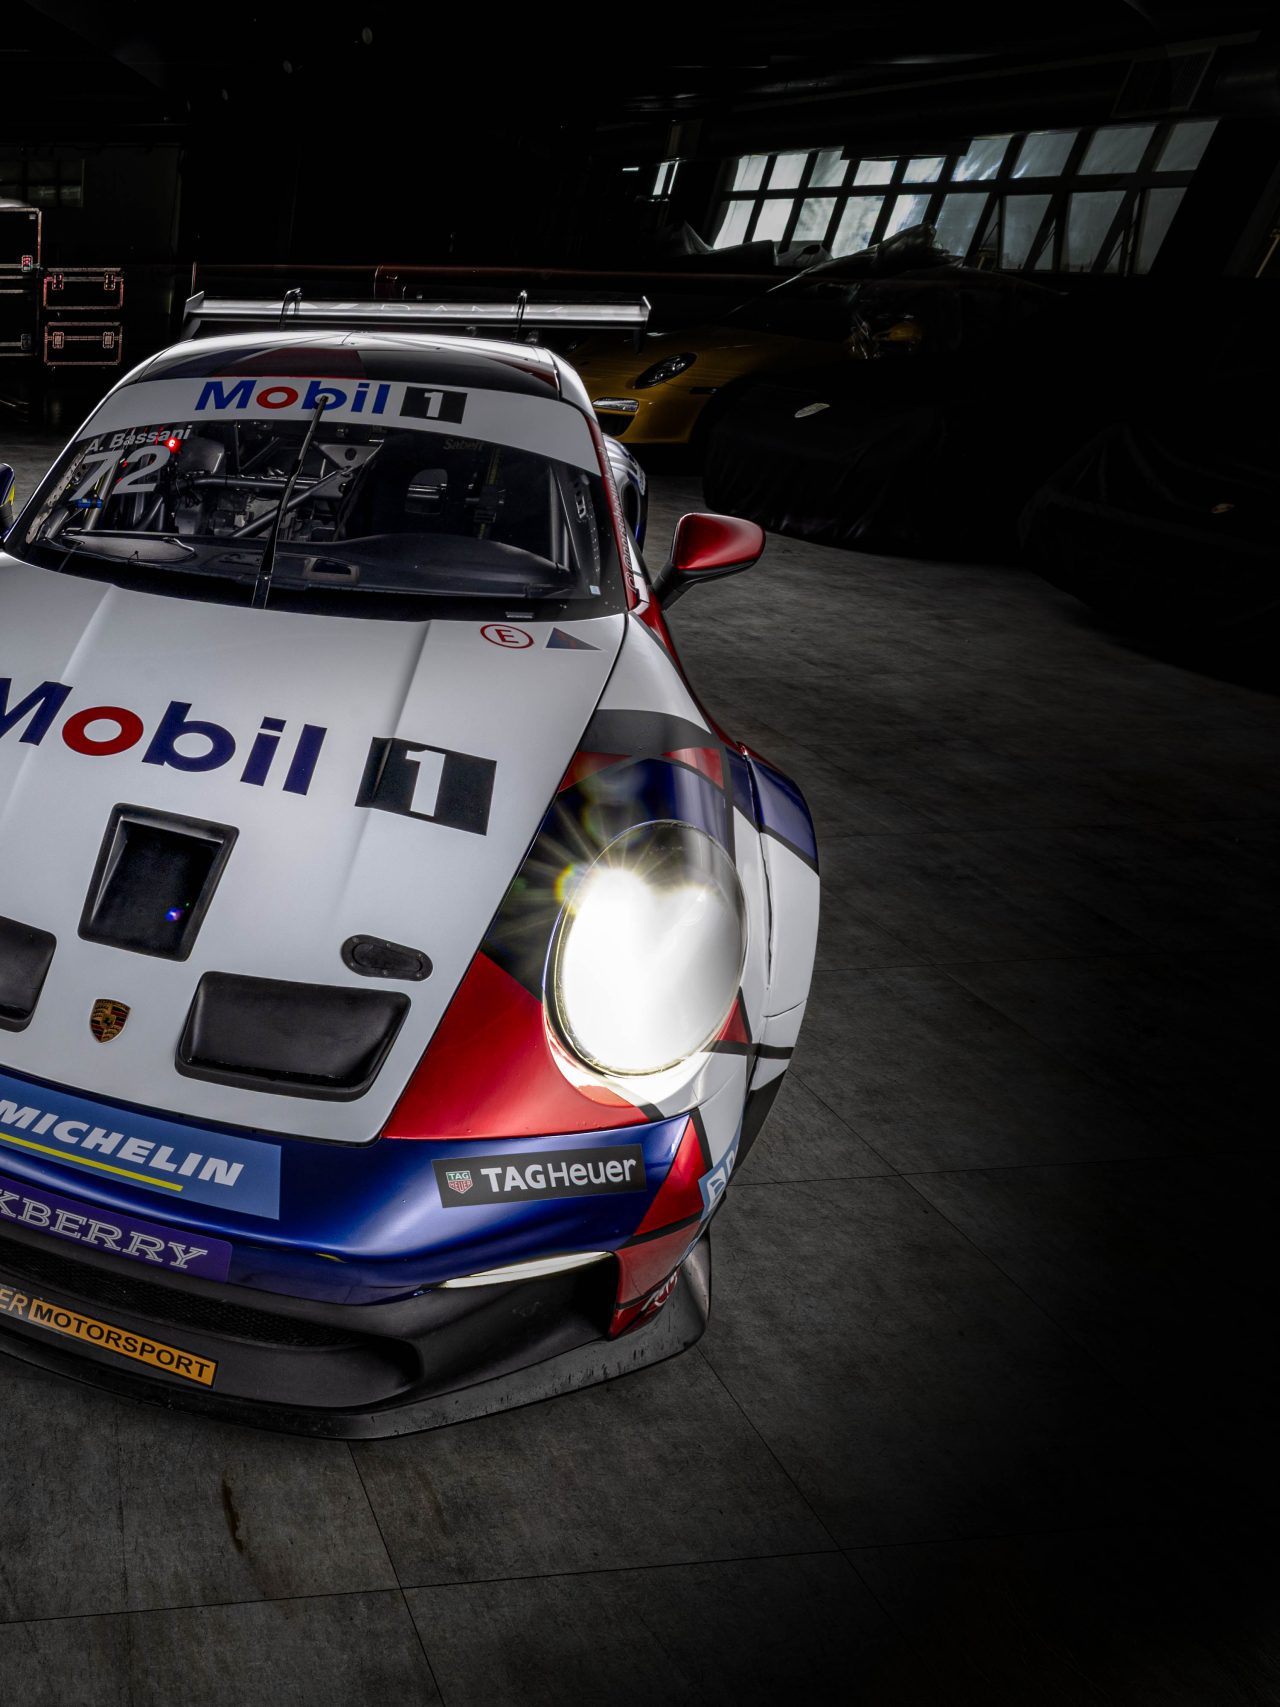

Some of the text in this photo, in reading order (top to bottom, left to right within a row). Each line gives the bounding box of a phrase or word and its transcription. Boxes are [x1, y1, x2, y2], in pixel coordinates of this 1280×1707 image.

[194, 379, 391, 415] Mobil
[85, 425, 192, 452] A. Bassani
[69, 444, 170, 501] 72
[448, 1172, 469, 1180] TAG
[34, 1303, 211, 1379] MOTORSPORT
